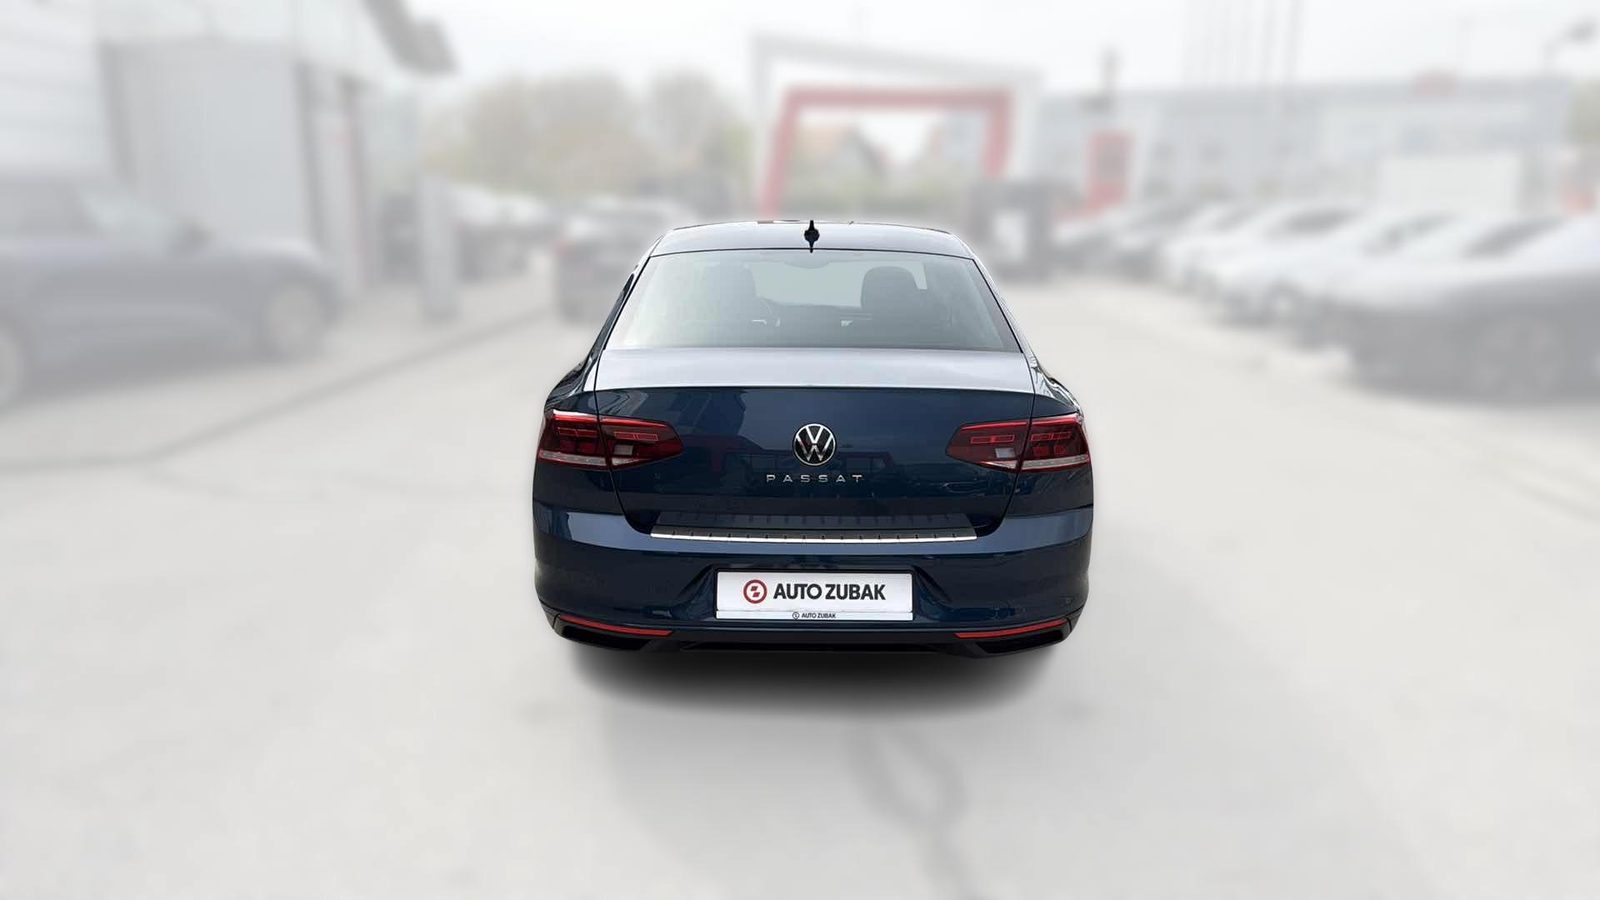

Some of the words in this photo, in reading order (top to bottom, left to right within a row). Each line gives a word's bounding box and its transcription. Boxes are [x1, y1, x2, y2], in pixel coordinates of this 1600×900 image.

[794, 423, 836, 466] VW
[766, 474, 863, 483] PASSAT
[773, 583, 822, 600] AUTO
[825, 584, 886, 600] ZUBAK
